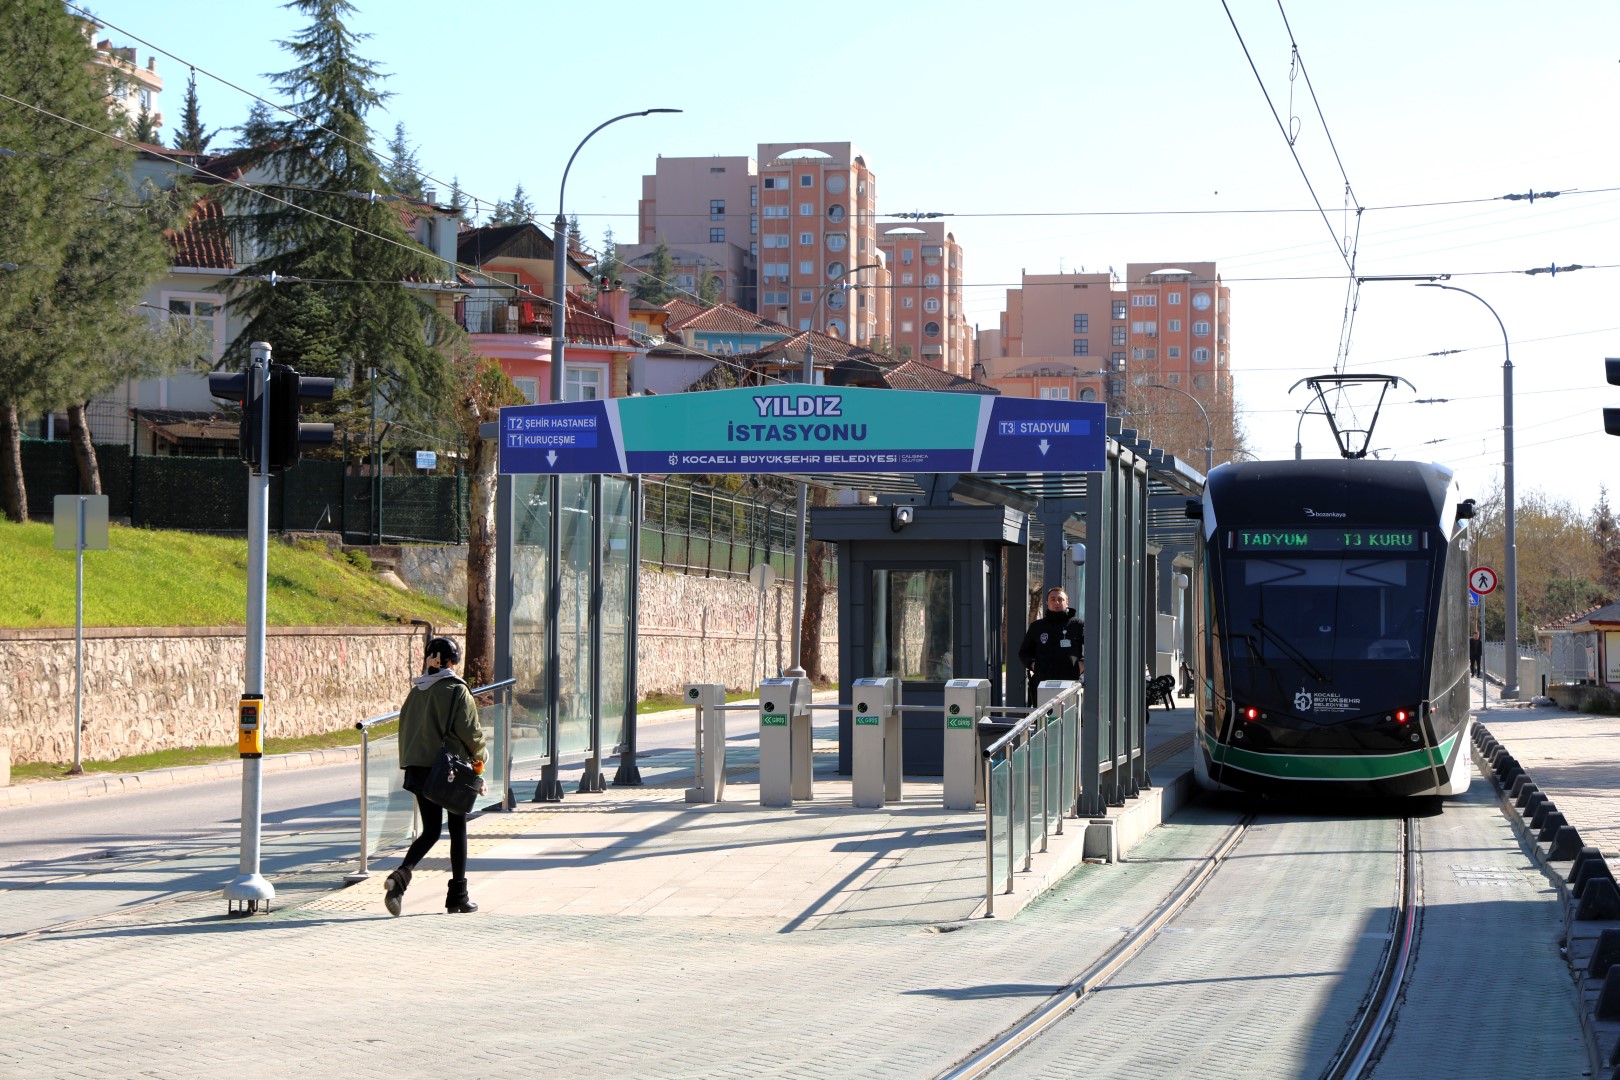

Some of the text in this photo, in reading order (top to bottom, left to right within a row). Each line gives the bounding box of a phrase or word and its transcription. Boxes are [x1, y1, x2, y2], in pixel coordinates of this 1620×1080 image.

[753, 395, 842, 417] YILDIZ
[509, 416, 597, 429] T2 ŞEHİR HASTANESİ
[1000, 422, 1070, 434] T3 STADYUM
[727, 420, 867, 441] İSTASYONU
[509, 435, 576, 447] T1 KURUÇEŞME
[740, 455, 821, 465] BÜYÜKŞEHİR
[1242, 533, 1413, 546] TADYUM T3 KURU
